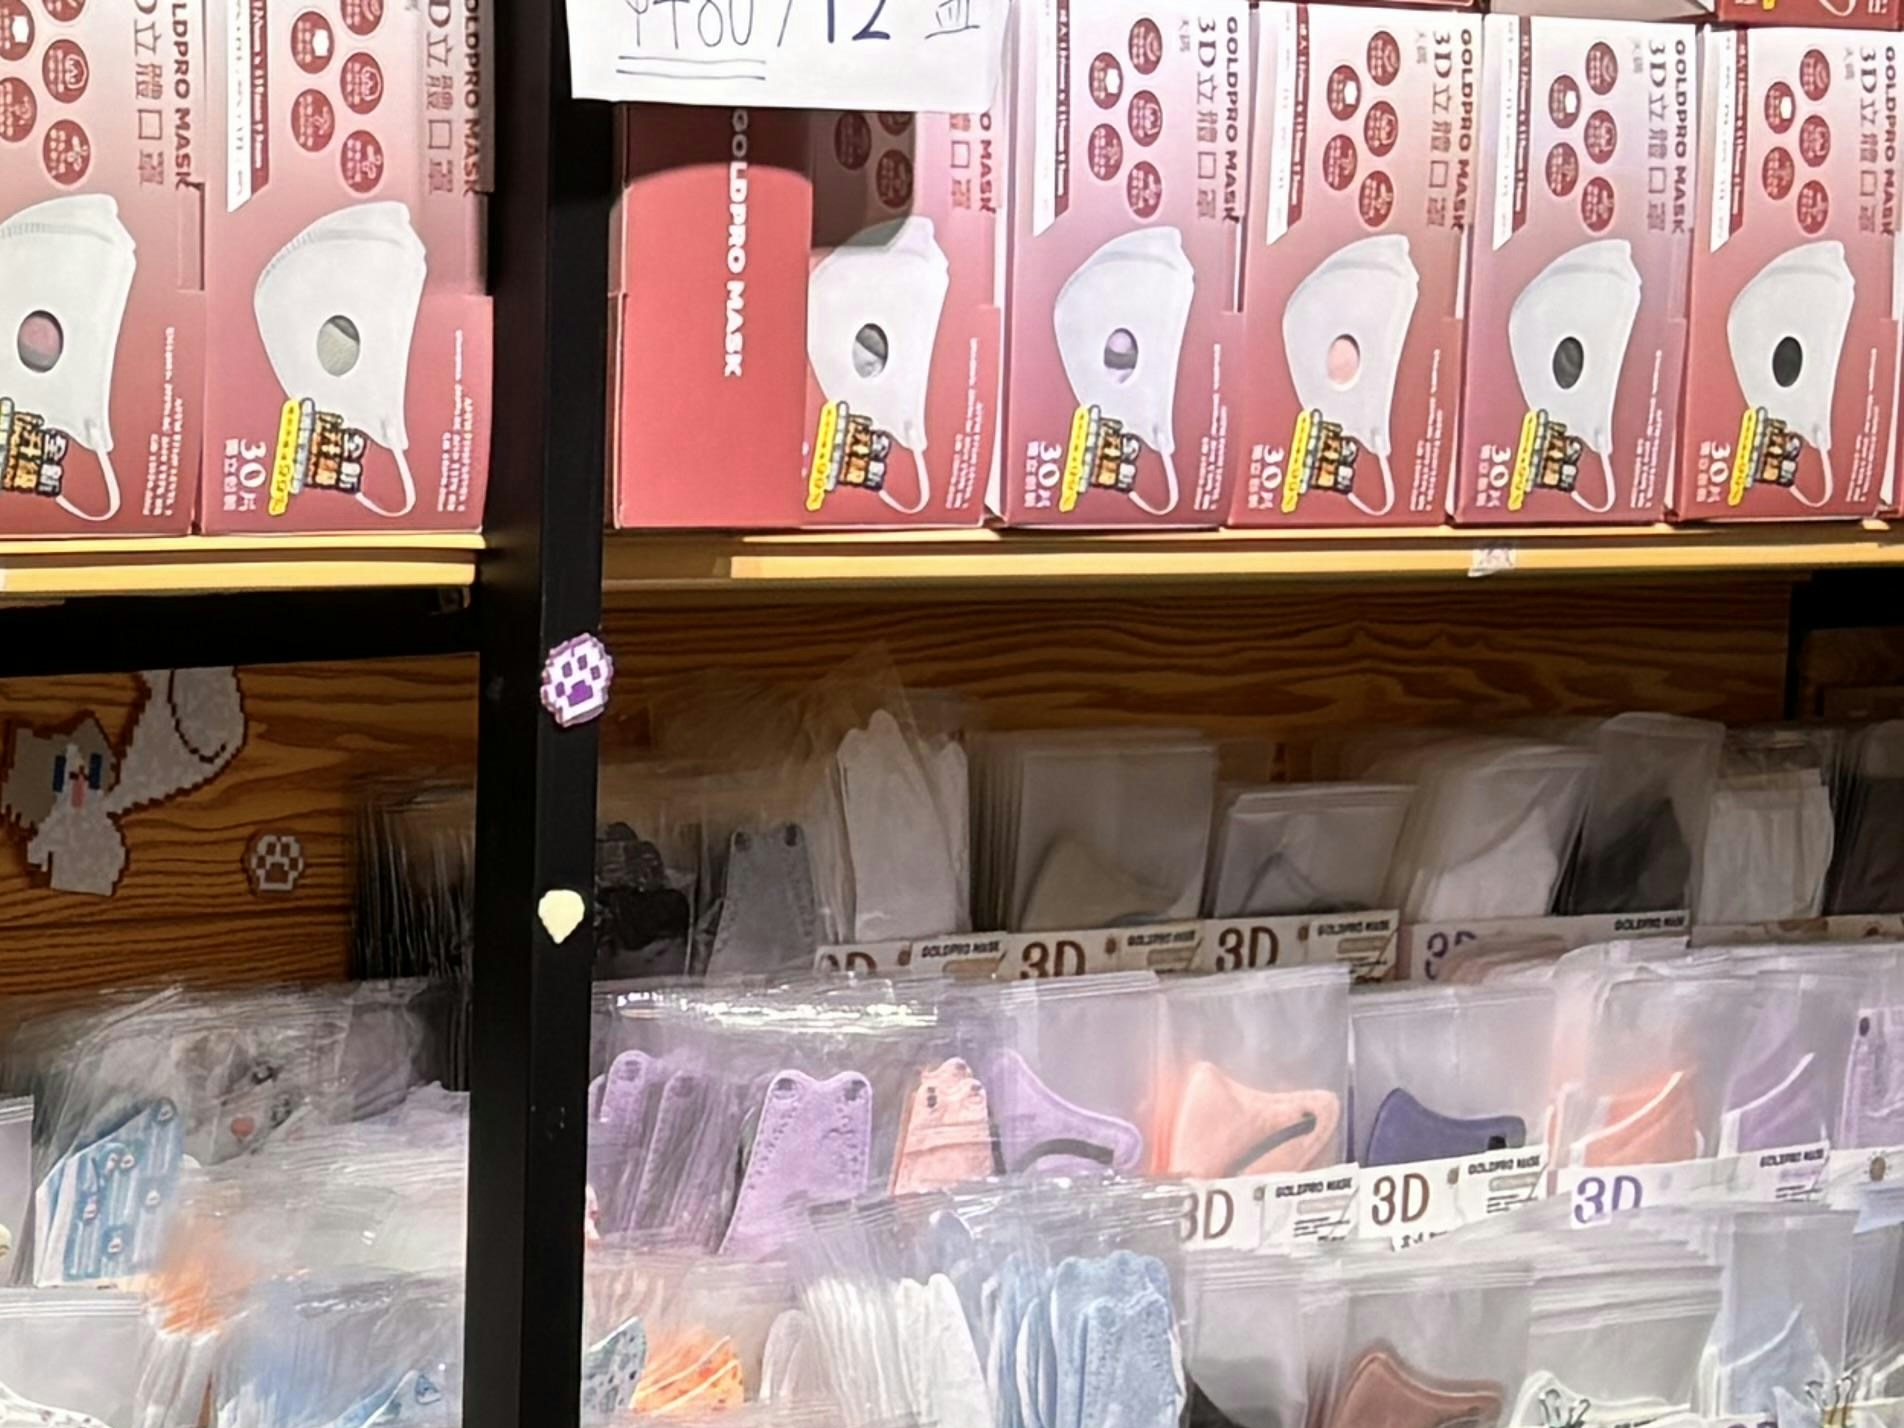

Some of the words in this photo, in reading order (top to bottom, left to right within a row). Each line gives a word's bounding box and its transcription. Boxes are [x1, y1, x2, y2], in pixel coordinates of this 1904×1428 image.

[1223, 16, 1241, 137] GOLDPRO
[1456, 29, 1475, 152] GOLDPRO
[1672, 39, 1687, 158] GOLDPRO
[729, 110, 750, 274] GOLDPRO
[723, 280, 745, 377] MASK
[1370, 1171, 1431, 1227] 3D
